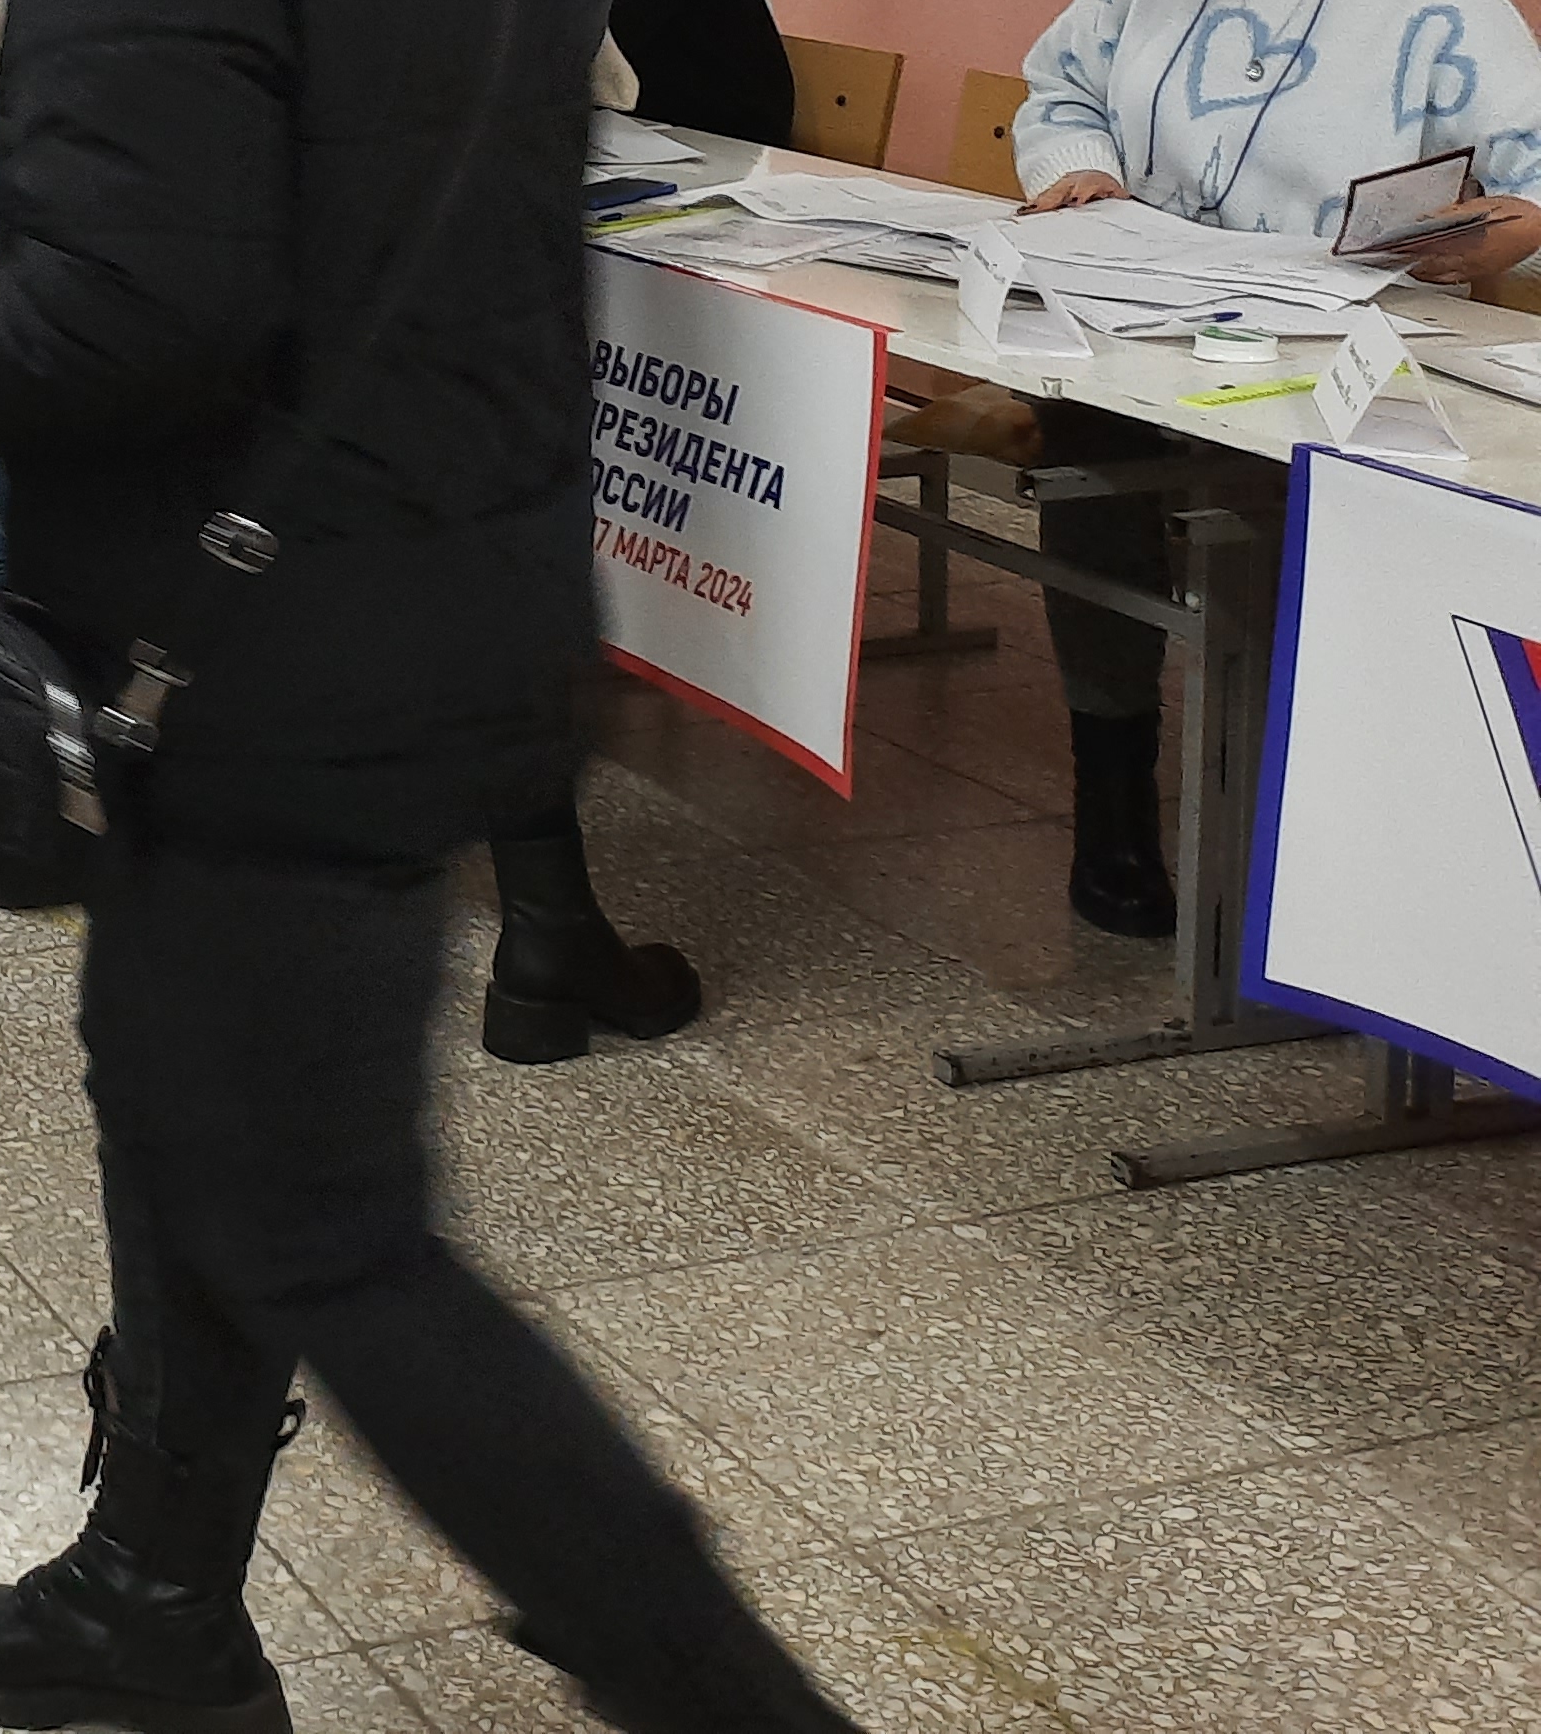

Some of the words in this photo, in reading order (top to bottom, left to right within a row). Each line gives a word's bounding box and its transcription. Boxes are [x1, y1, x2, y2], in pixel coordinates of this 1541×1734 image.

[592, 339, 740, 426] ВЫБОРЫ
[593, 399, 786, 512] РЕЗИДЕНТА
[612, 524, 693, 592] МАРТА
[693, 561, 754, 618] 2024
